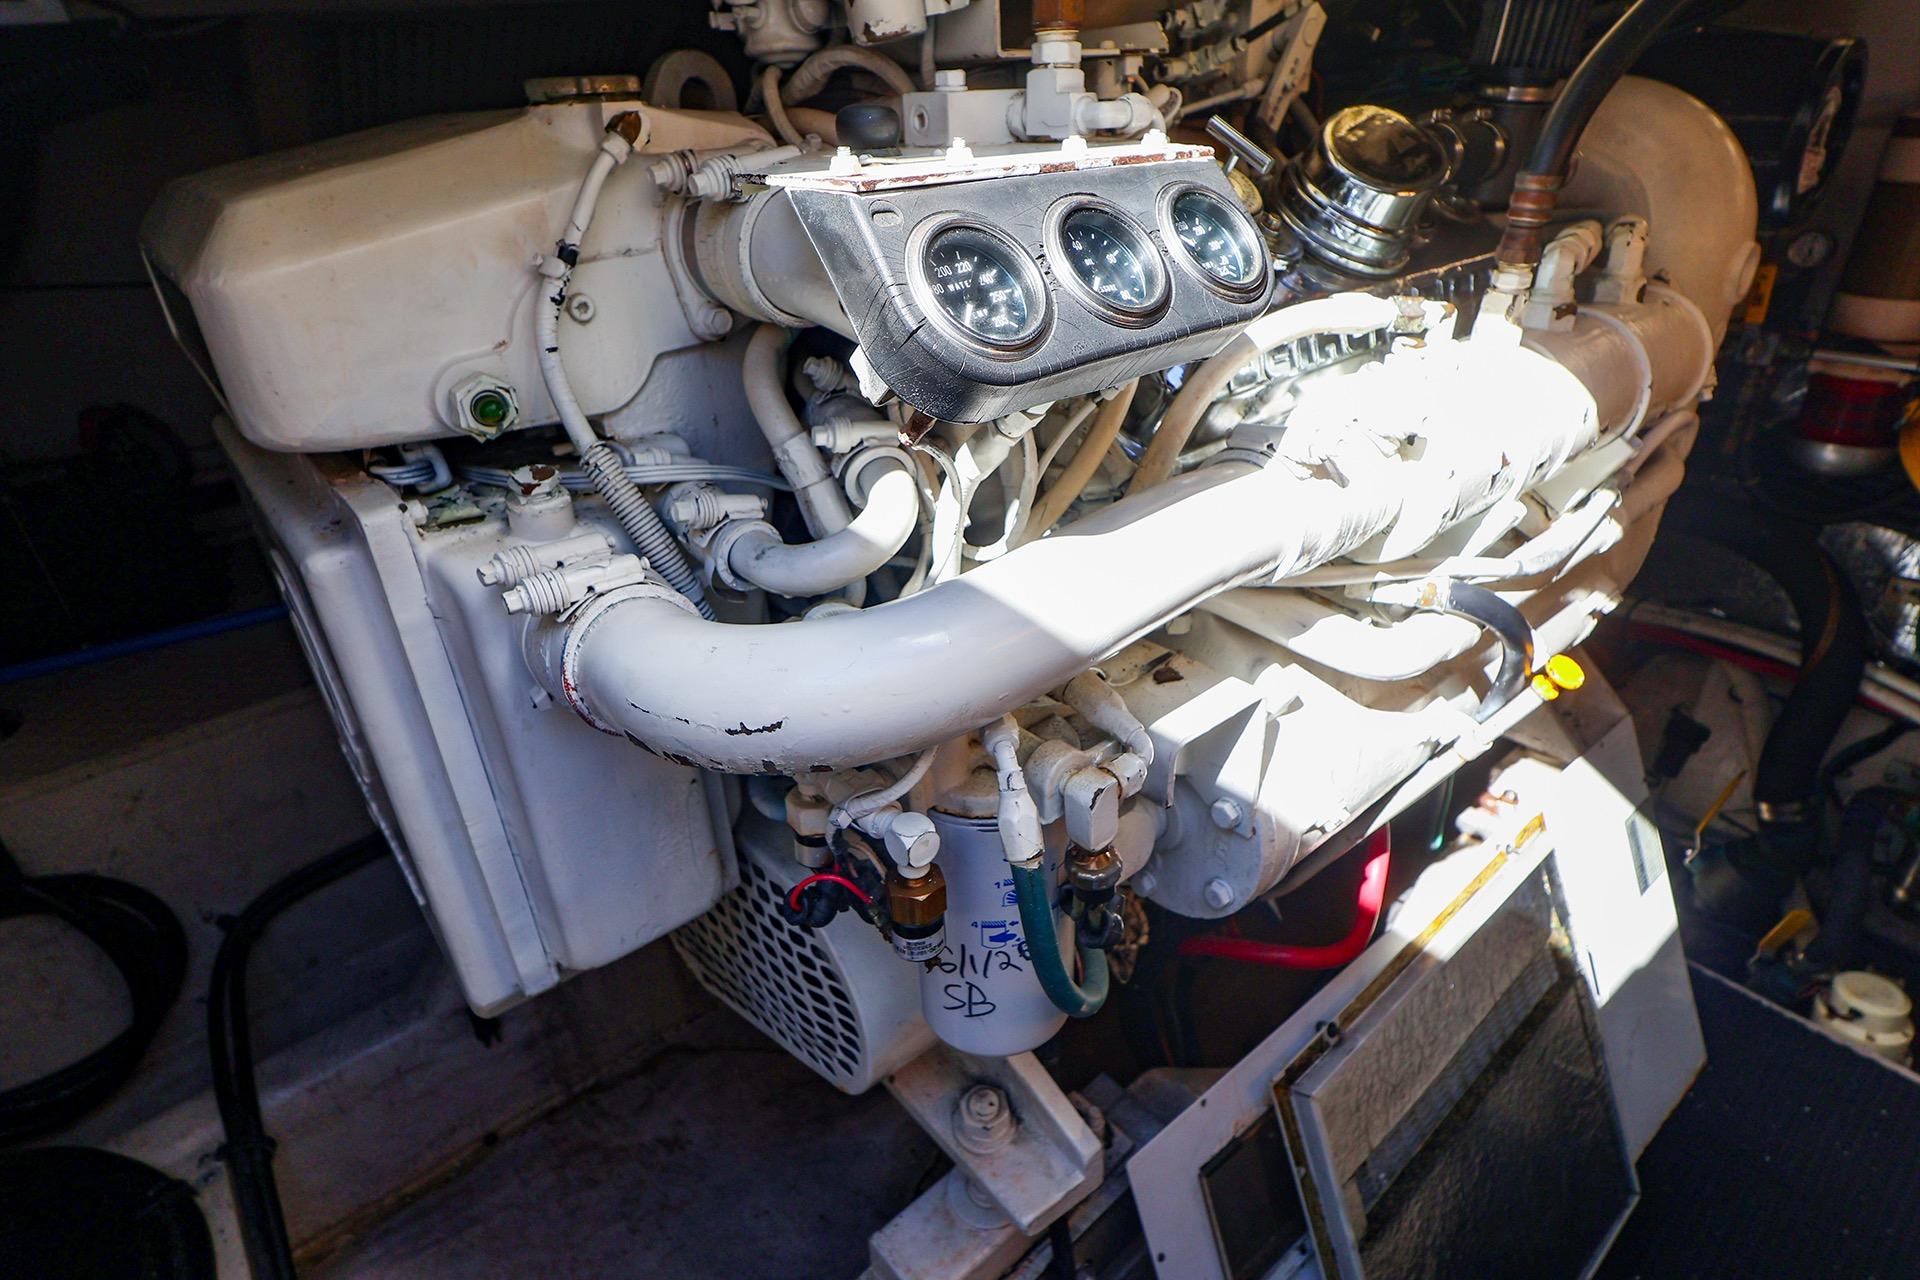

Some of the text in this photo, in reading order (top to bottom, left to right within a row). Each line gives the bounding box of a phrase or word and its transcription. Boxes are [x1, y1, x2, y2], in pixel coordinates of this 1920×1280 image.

[934, 265, 953, 278] 200
[955, 261, 973, 274] 220
[947, 279, 973, 292] WATE
[943, 981, 996, 1018] SB
